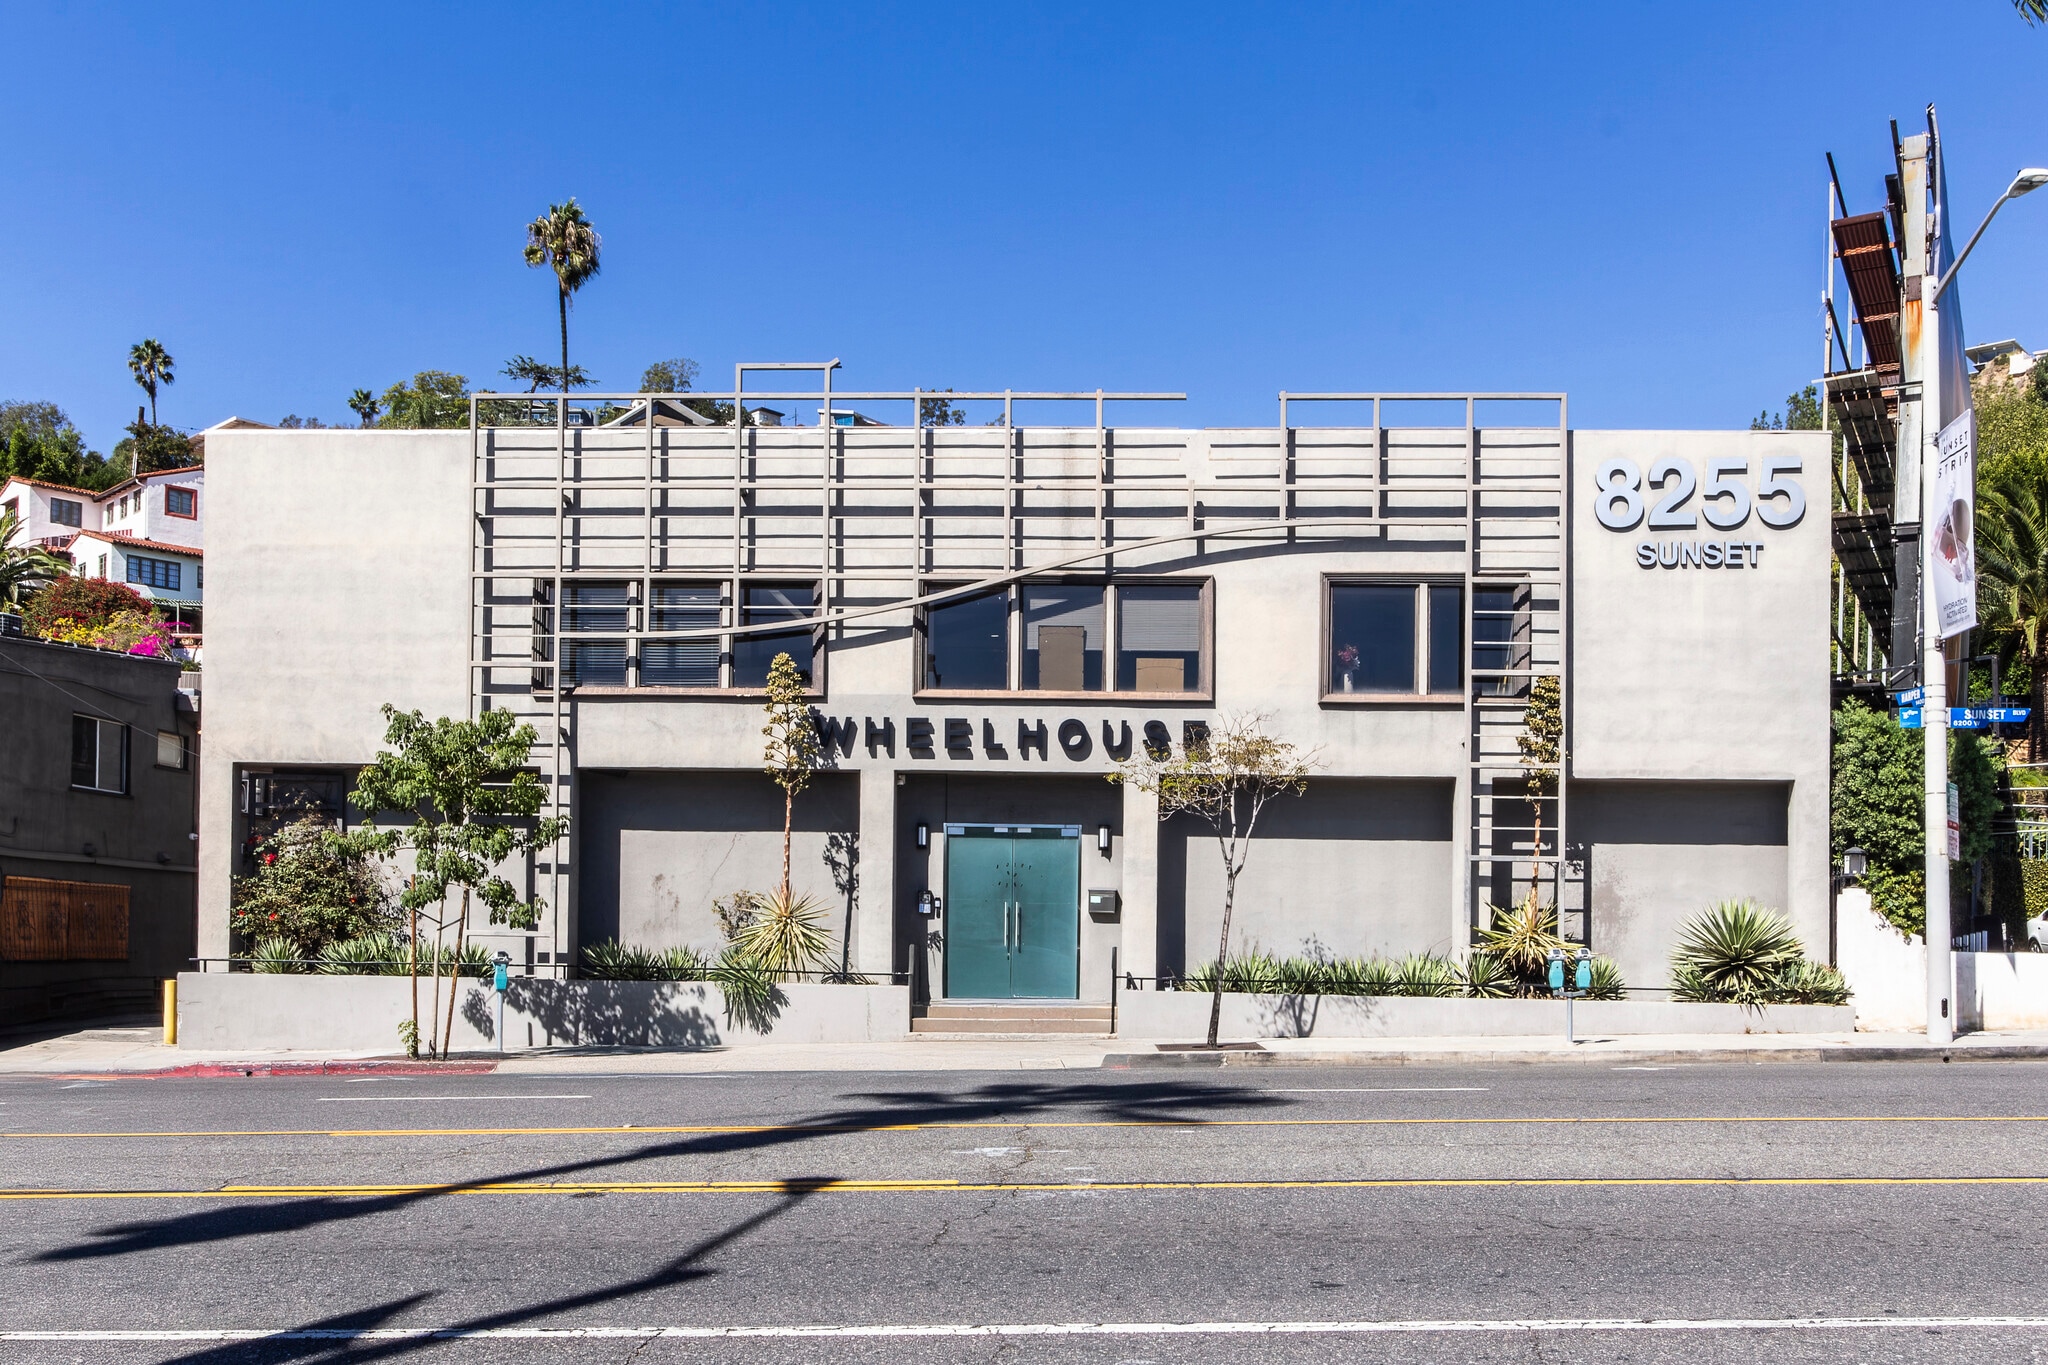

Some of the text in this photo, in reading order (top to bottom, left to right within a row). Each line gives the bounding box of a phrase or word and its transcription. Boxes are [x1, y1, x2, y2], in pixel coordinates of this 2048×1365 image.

[1938, 452, 1968, 478] STRIP
[1595, 456, 1806, 531] 8255
[1637, 541, 1764, 569] SUNSET
[1964, 709, 2007, 720] SUNSET
